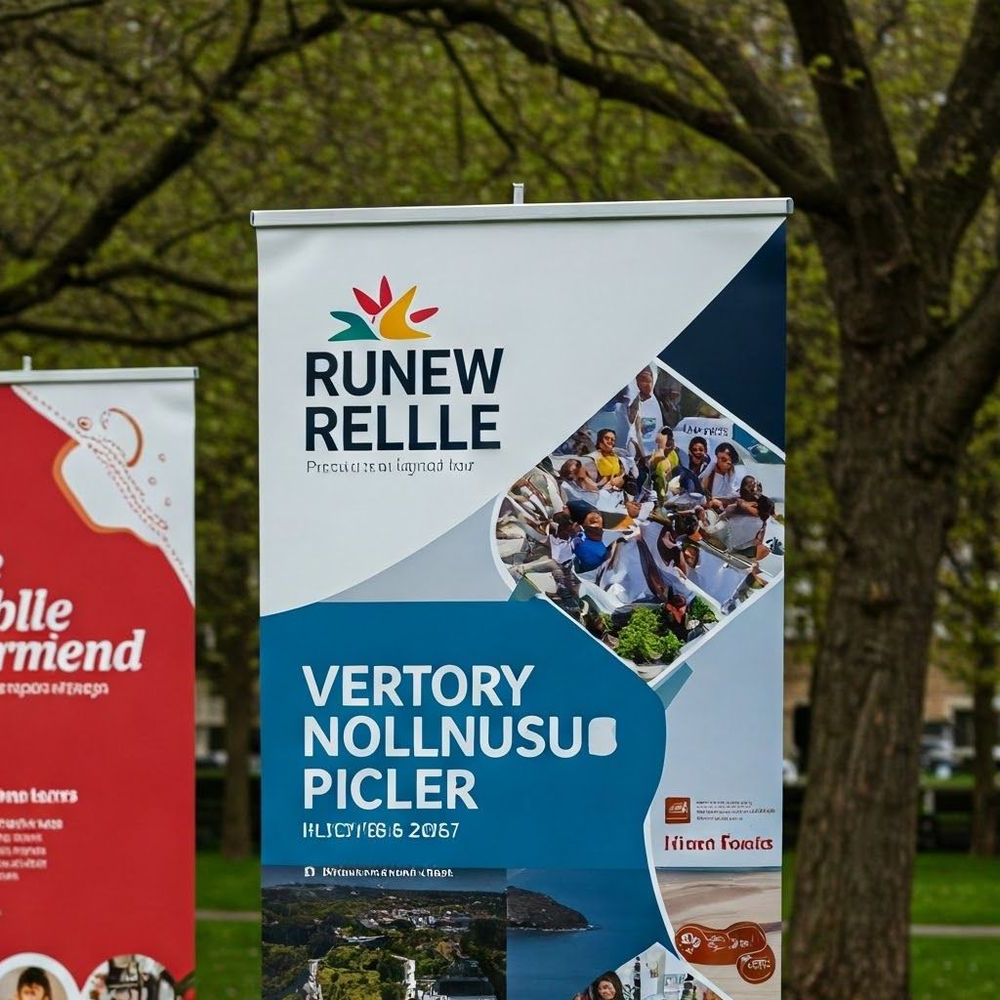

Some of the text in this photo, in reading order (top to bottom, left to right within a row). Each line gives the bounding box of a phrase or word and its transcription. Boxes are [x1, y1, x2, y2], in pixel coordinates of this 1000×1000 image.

[305, 347, 504, 397] RUNEW
[305, 404, 501, 452] RELLLE
[302, 664, 535, 707] VERTORY
[304, 767, 479, 811] PICLER
